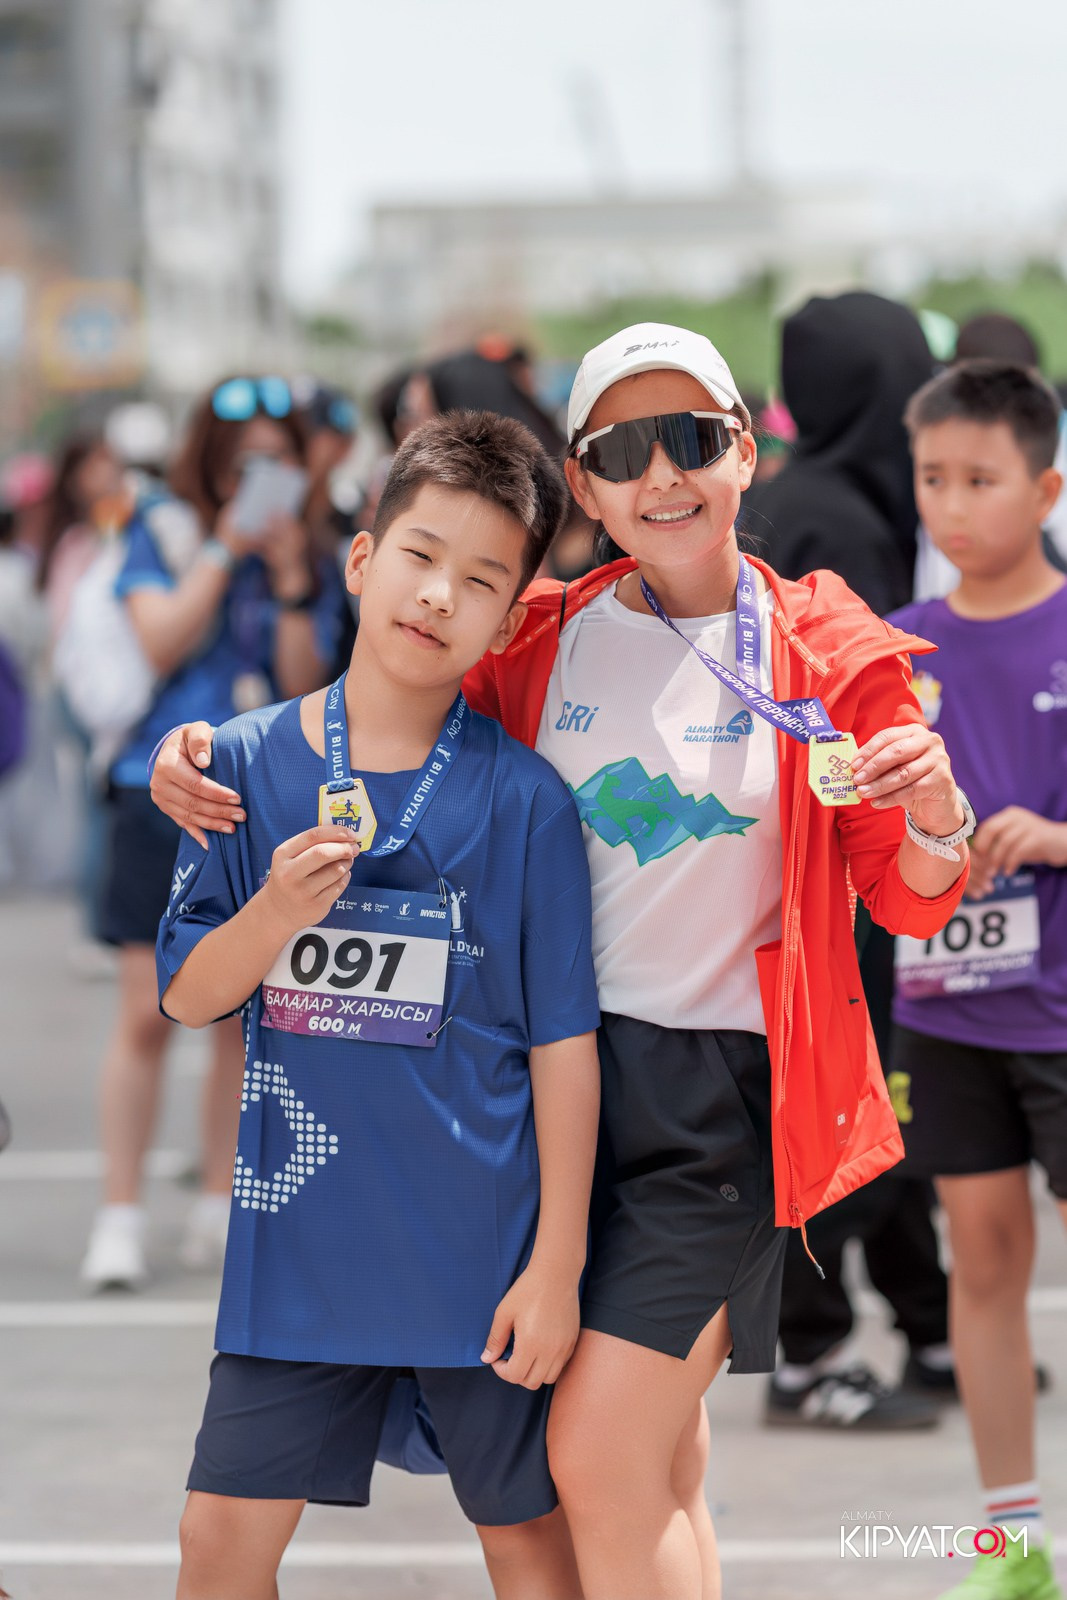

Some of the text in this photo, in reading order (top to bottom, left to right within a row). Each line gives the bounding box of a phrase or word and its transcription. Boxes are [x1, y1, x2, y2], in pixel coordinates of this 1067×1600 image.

[743, 630, 754, 642] BI
[328, 688, 340, 710] City
[446, 719, 462, 739] City
[684, 725, 725, 734] ALMATY
[331, 736, 342, 748] BI
[682, 734, 740, 743] MARATHON
[332, 750, 345, 779] JULD
[432, 761, 443, 776] BI
[822, 785, 858, 794] FINISHER
[399, 774, 435, 829] JULDYZAI
[420, 909, 447, 919] INVICTUS
[290, 933, 407, 993] 091
[266, 990, 433, 1023] БАЛАЛАР ЖАРЫСЫ
[308, 1015, 345, 1033] 600
